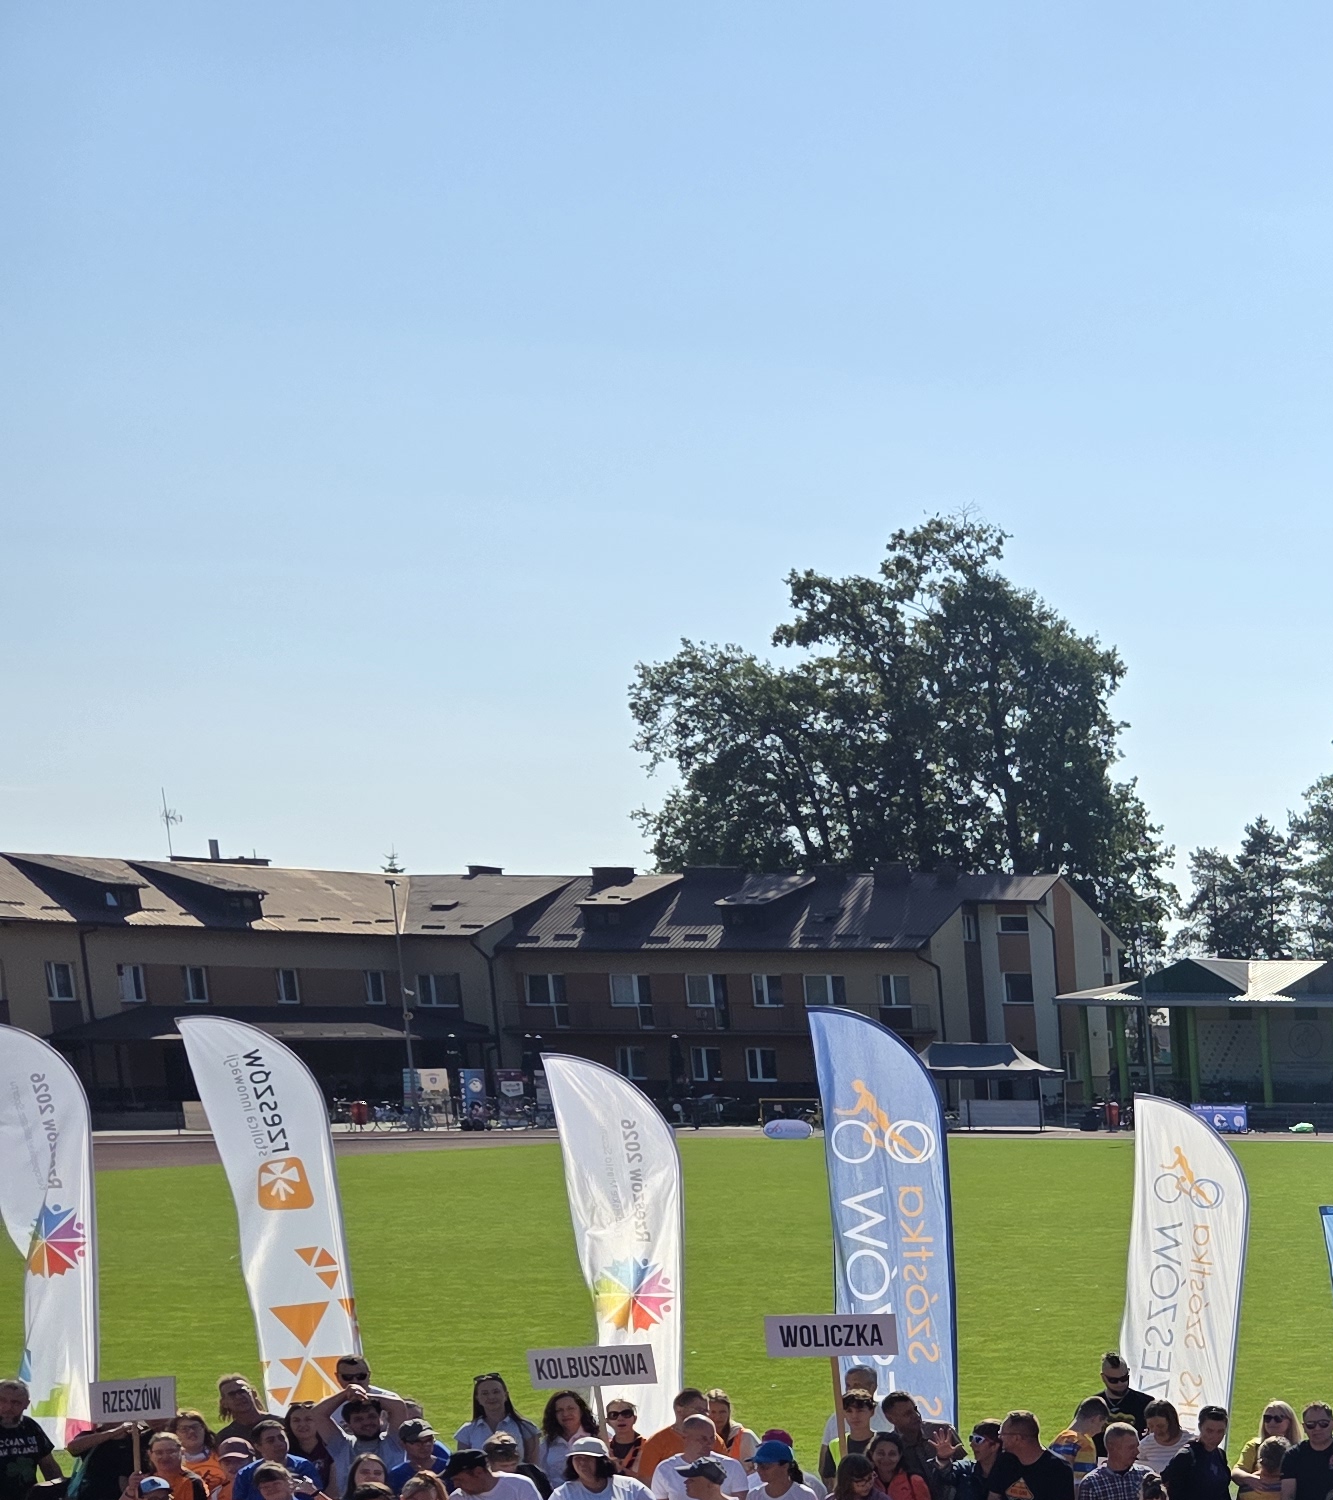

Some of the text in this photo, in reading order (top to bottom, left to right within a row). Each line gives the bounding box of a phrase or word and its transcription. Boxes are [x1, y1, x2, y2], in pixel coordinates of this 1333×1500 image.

[779, 1323, 884, 1348] WOLICZKA
[535, 1352, 648, 1381] KOLBUSZOWA
[102, 1385, 162, 1414] RZESZÓW
